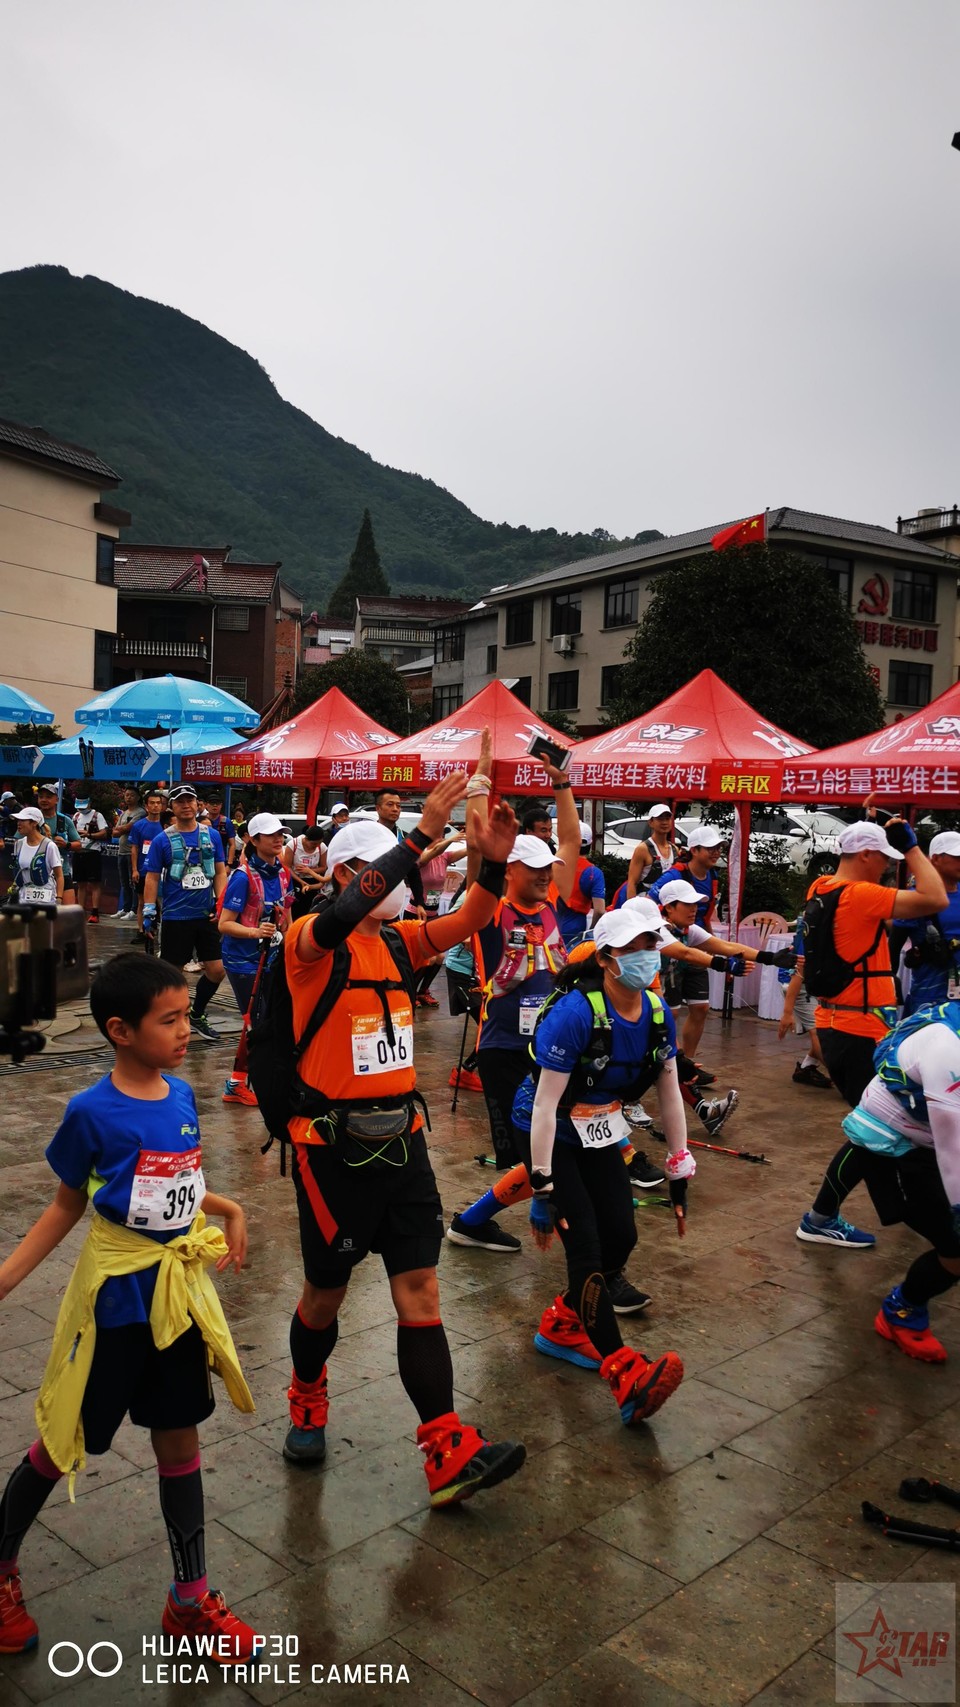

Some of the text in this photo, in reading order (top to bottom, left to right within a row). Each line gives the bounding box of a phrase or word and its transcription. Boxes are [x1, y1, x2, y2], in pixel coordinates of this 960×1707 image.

[103, 749, 127, 766] 爆锐
[382, 766, 413, 782] 会务组
[514, 763, 706, 791] 战马量型维生素饮料
[720, 775, 771, 795] 贵宾区
[191, 876, 205, 887] 298
[32, 890, 45, 900] 375
[586, 1119, 613, 1142] 068
[162, 1183, 196, 1221] 399
